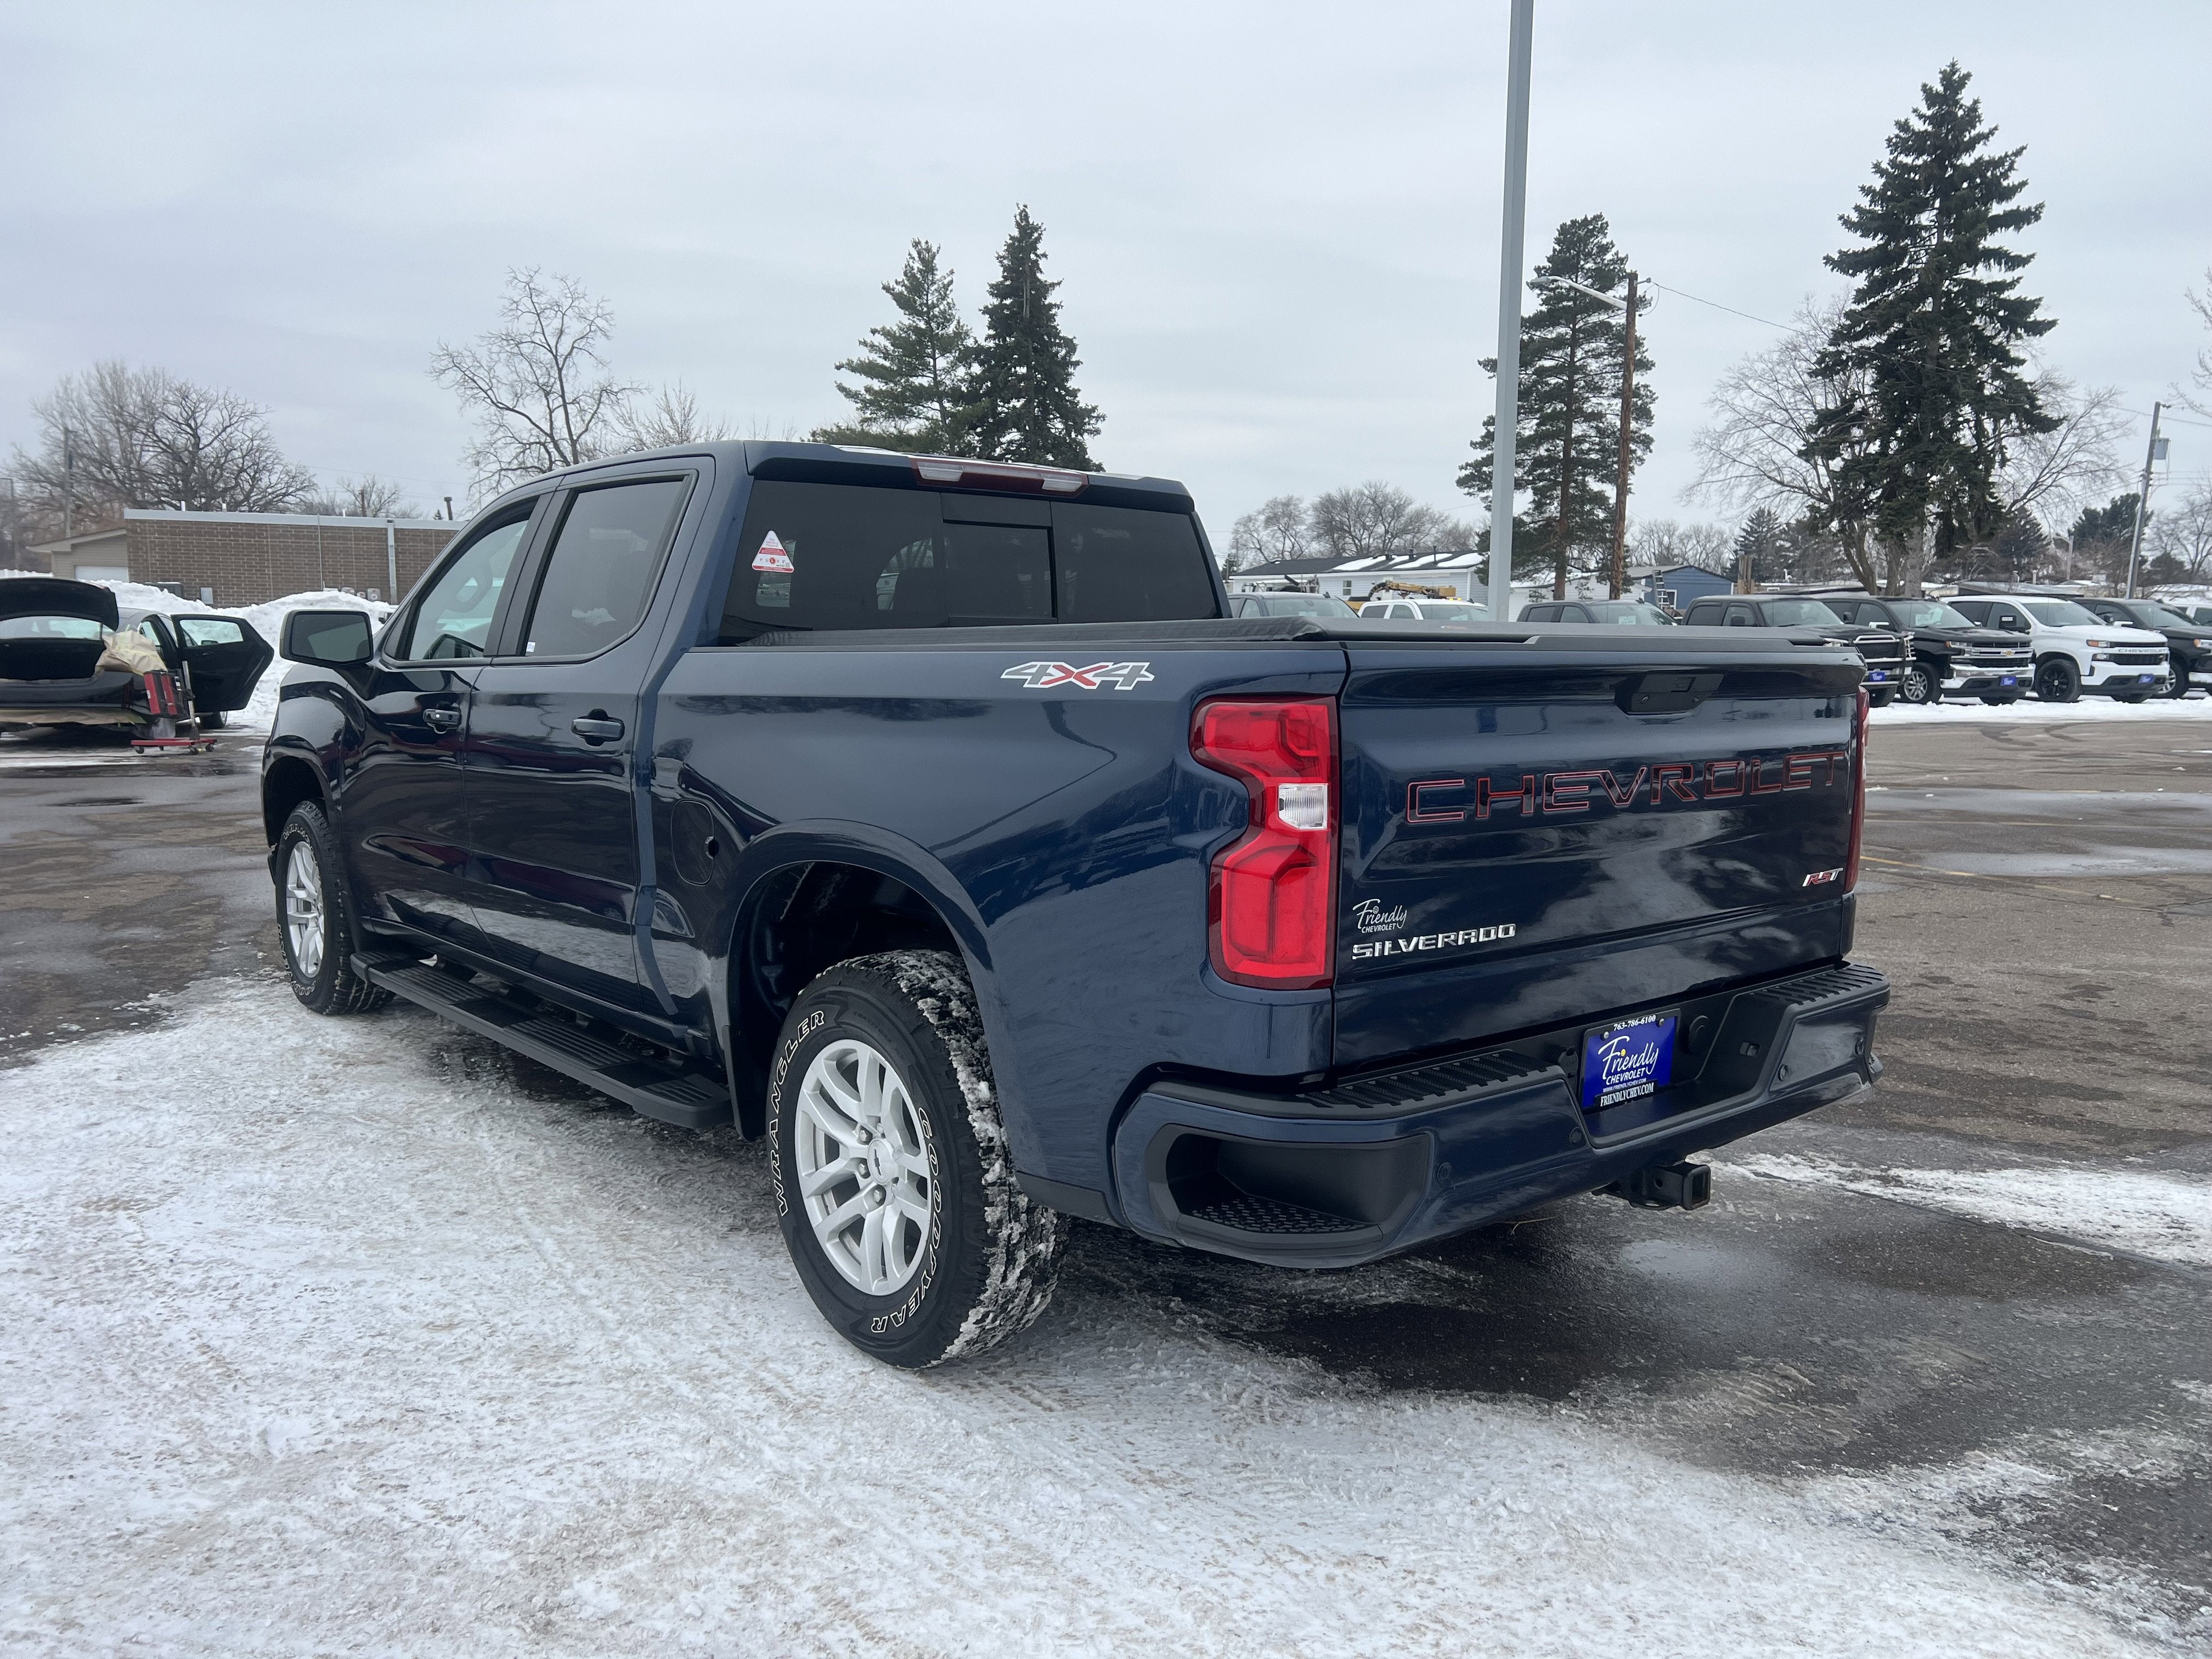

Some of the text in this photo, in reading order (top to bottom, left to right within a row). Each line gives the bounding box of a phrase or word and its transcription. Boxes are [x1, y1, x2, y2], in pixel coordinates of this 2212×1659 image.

[1406, 751, 1845, 825] CHEVROLET
[1802, 867, 1843, 887] RST
[1352, 899, 1407, 929] Friendly
[1361, 923, 1396, 933] CHEVROLET
[1352, 923, 1516, 960] SILVERADO
[1613, 1014, 1656, 1031] 763-786-6100
[1598, 1035, 1658, 1080] Friendly
[1606, 1068, 1645, 1085] CHEVROLET
[1600, 1082, 1655, 1107] FRIENDLYCHEV.COM
[769, 1011, 824, 1216] WRANGLER
[871, 1107, 941, 1333] GOODYEAR
